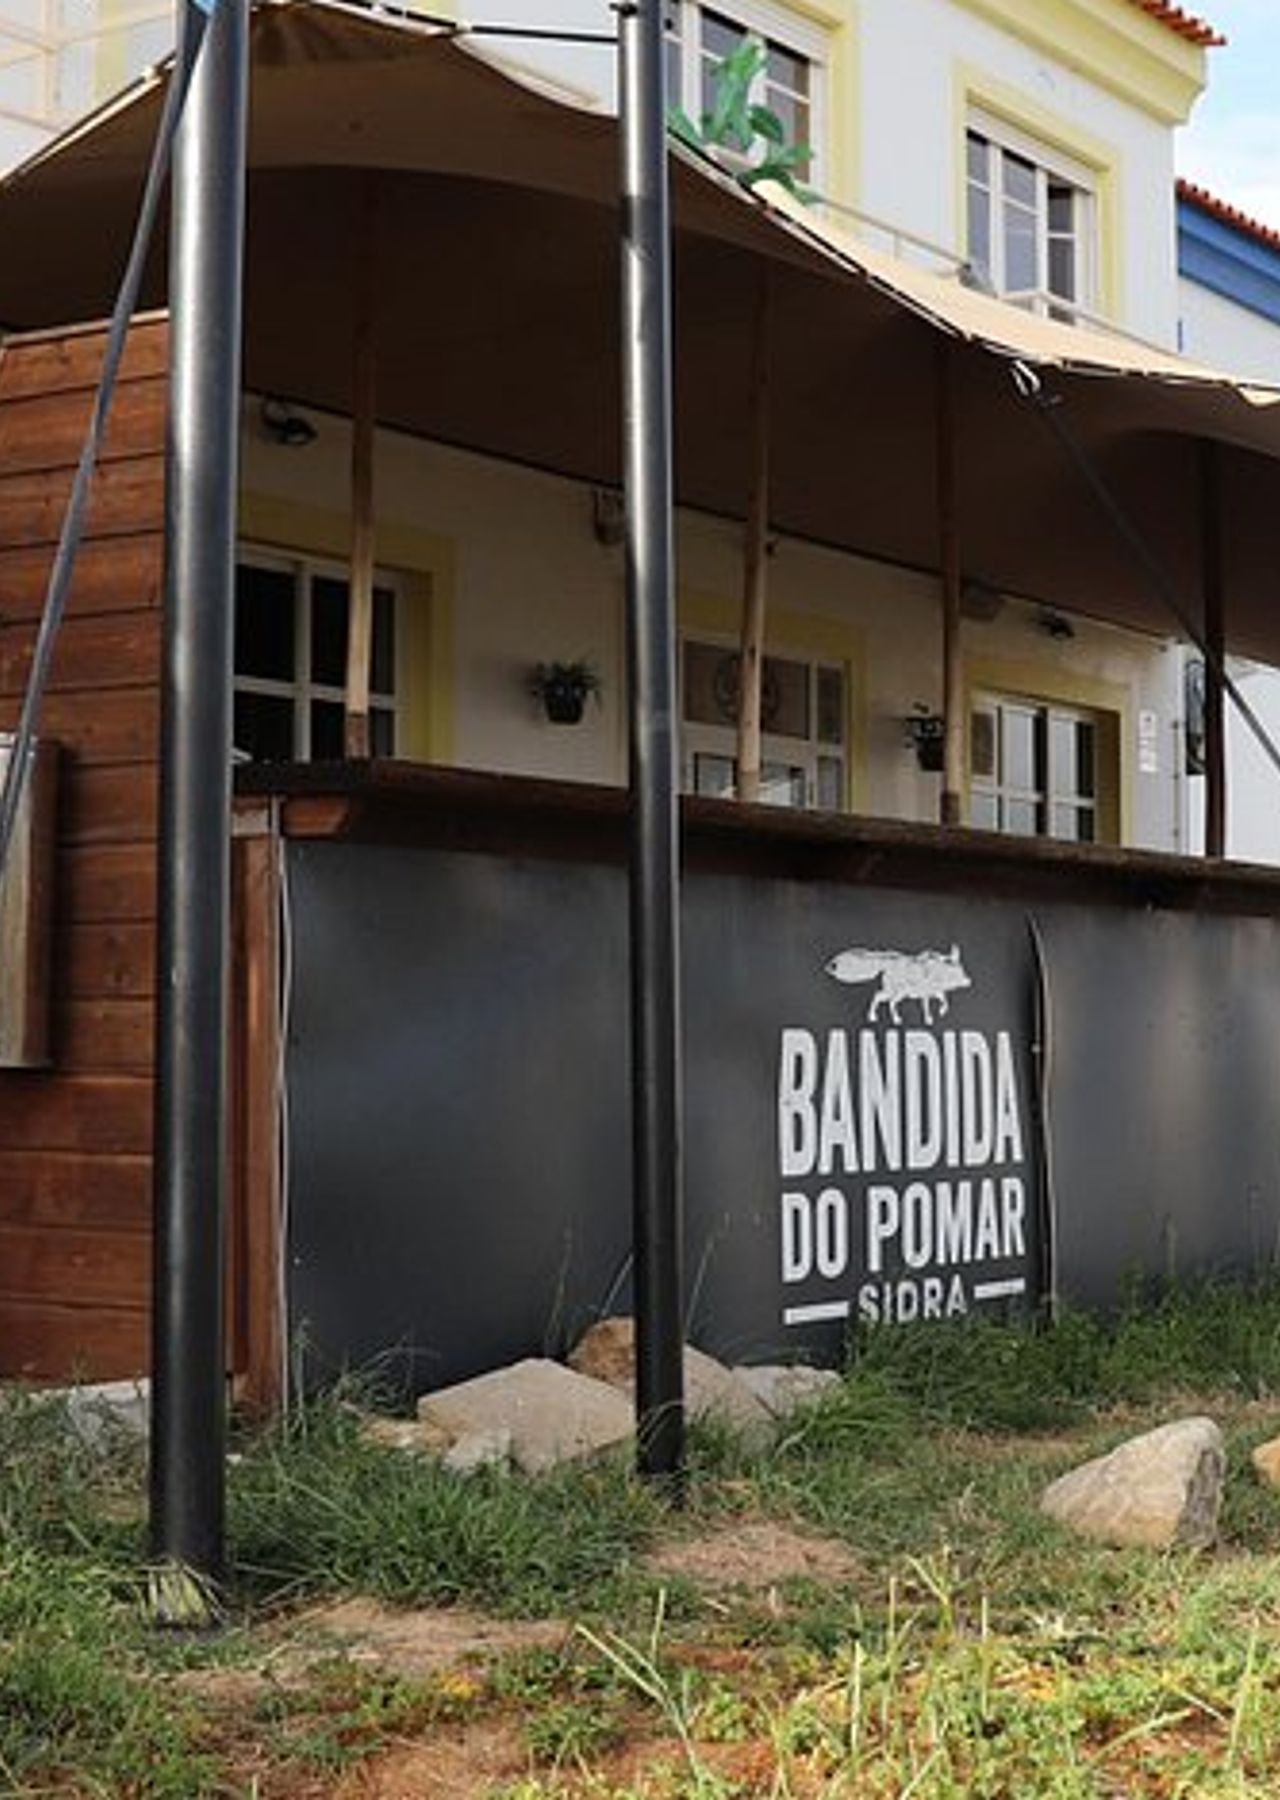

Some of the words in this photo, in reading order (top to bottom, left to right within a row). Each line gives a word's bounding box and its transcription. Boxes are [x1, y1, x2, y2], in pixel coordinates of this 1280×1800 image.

[778, 1028, 1024, 1176] BANDIDA
[781, 1187, 849, 1283] DO
[867, 1176, 1026, 1273] POMAR
[858, 1274, 968, 1324] SIDRA
